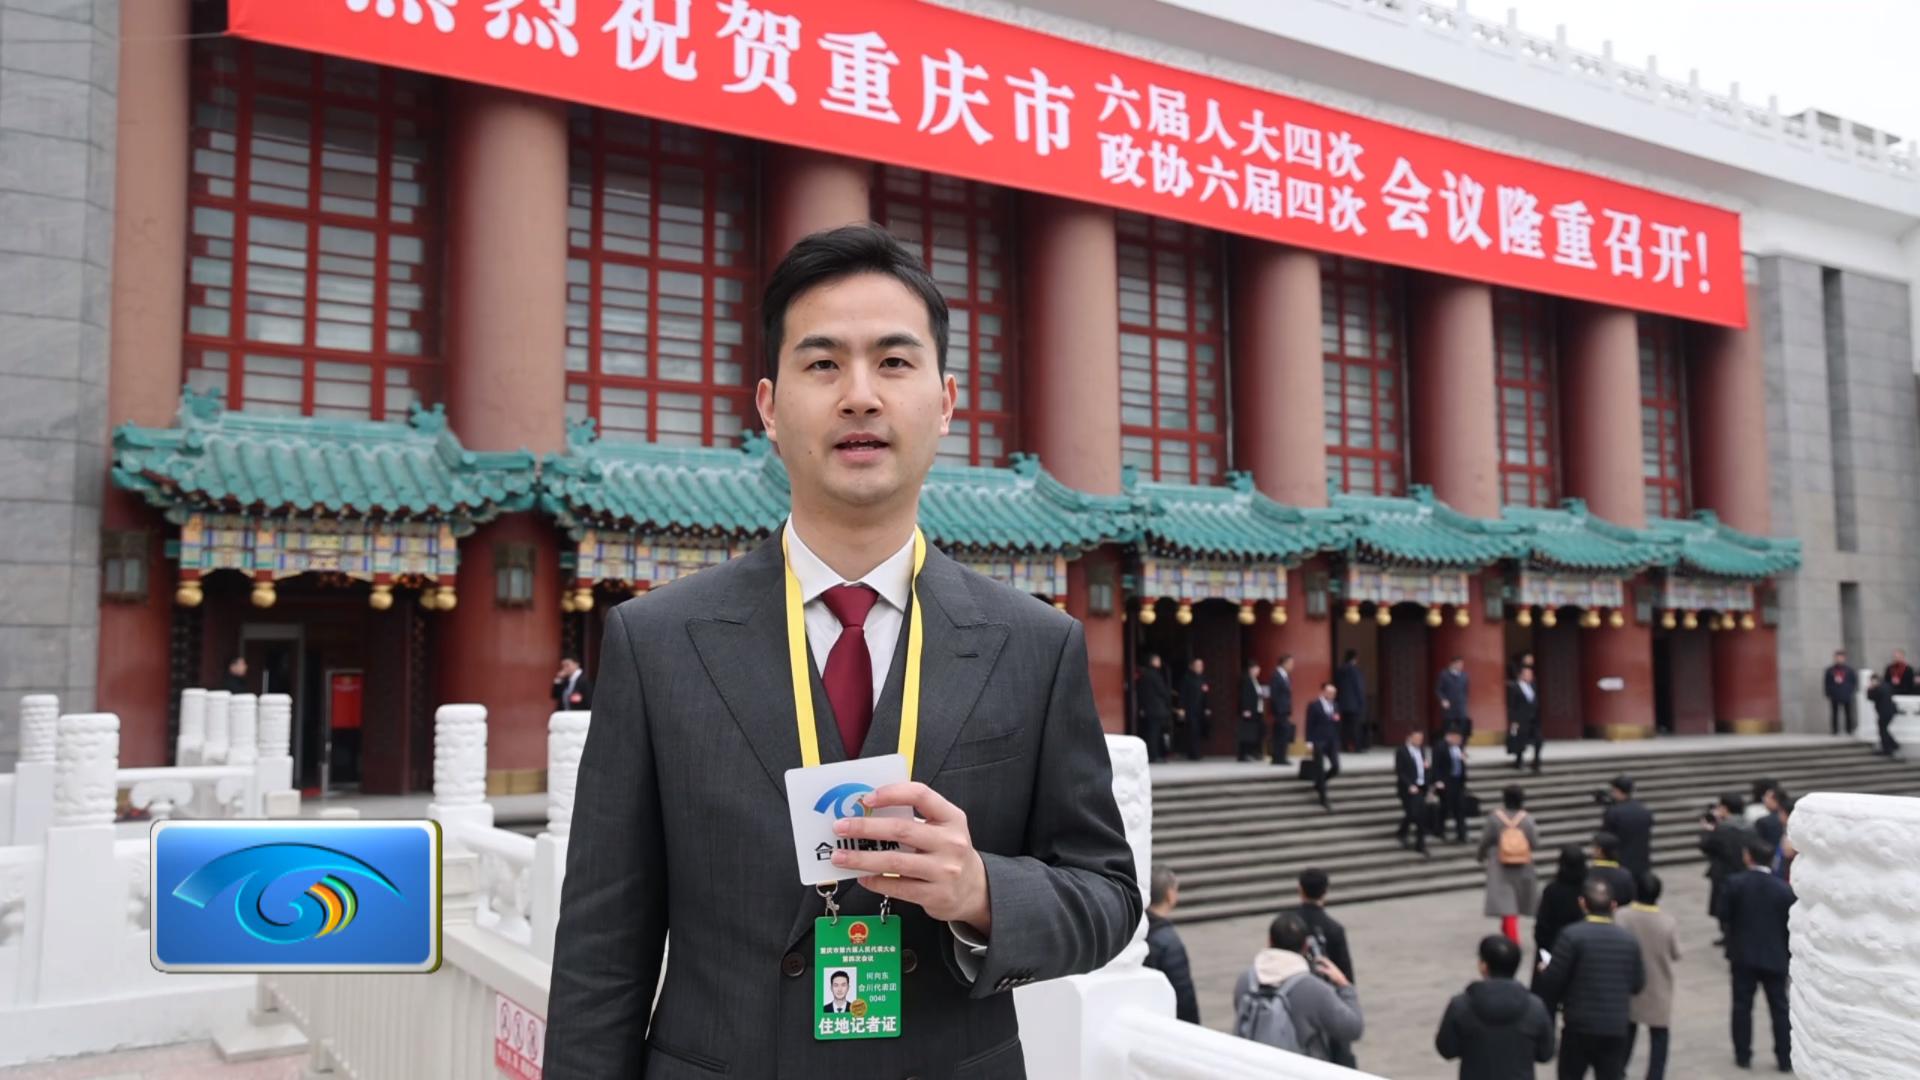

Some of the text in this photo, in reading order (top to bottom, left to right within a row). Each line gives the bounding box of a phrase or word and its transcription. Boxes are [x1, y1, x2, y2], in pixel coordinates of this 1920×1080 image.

[346, 0, 1076, 156] 祝贺重庆市
[1096, 74, 1365, 182] 六届人大四次
[1096, 132, 1368, 236] 政协六届四次
[819, 1016, 897, 1034] 住地记者证
